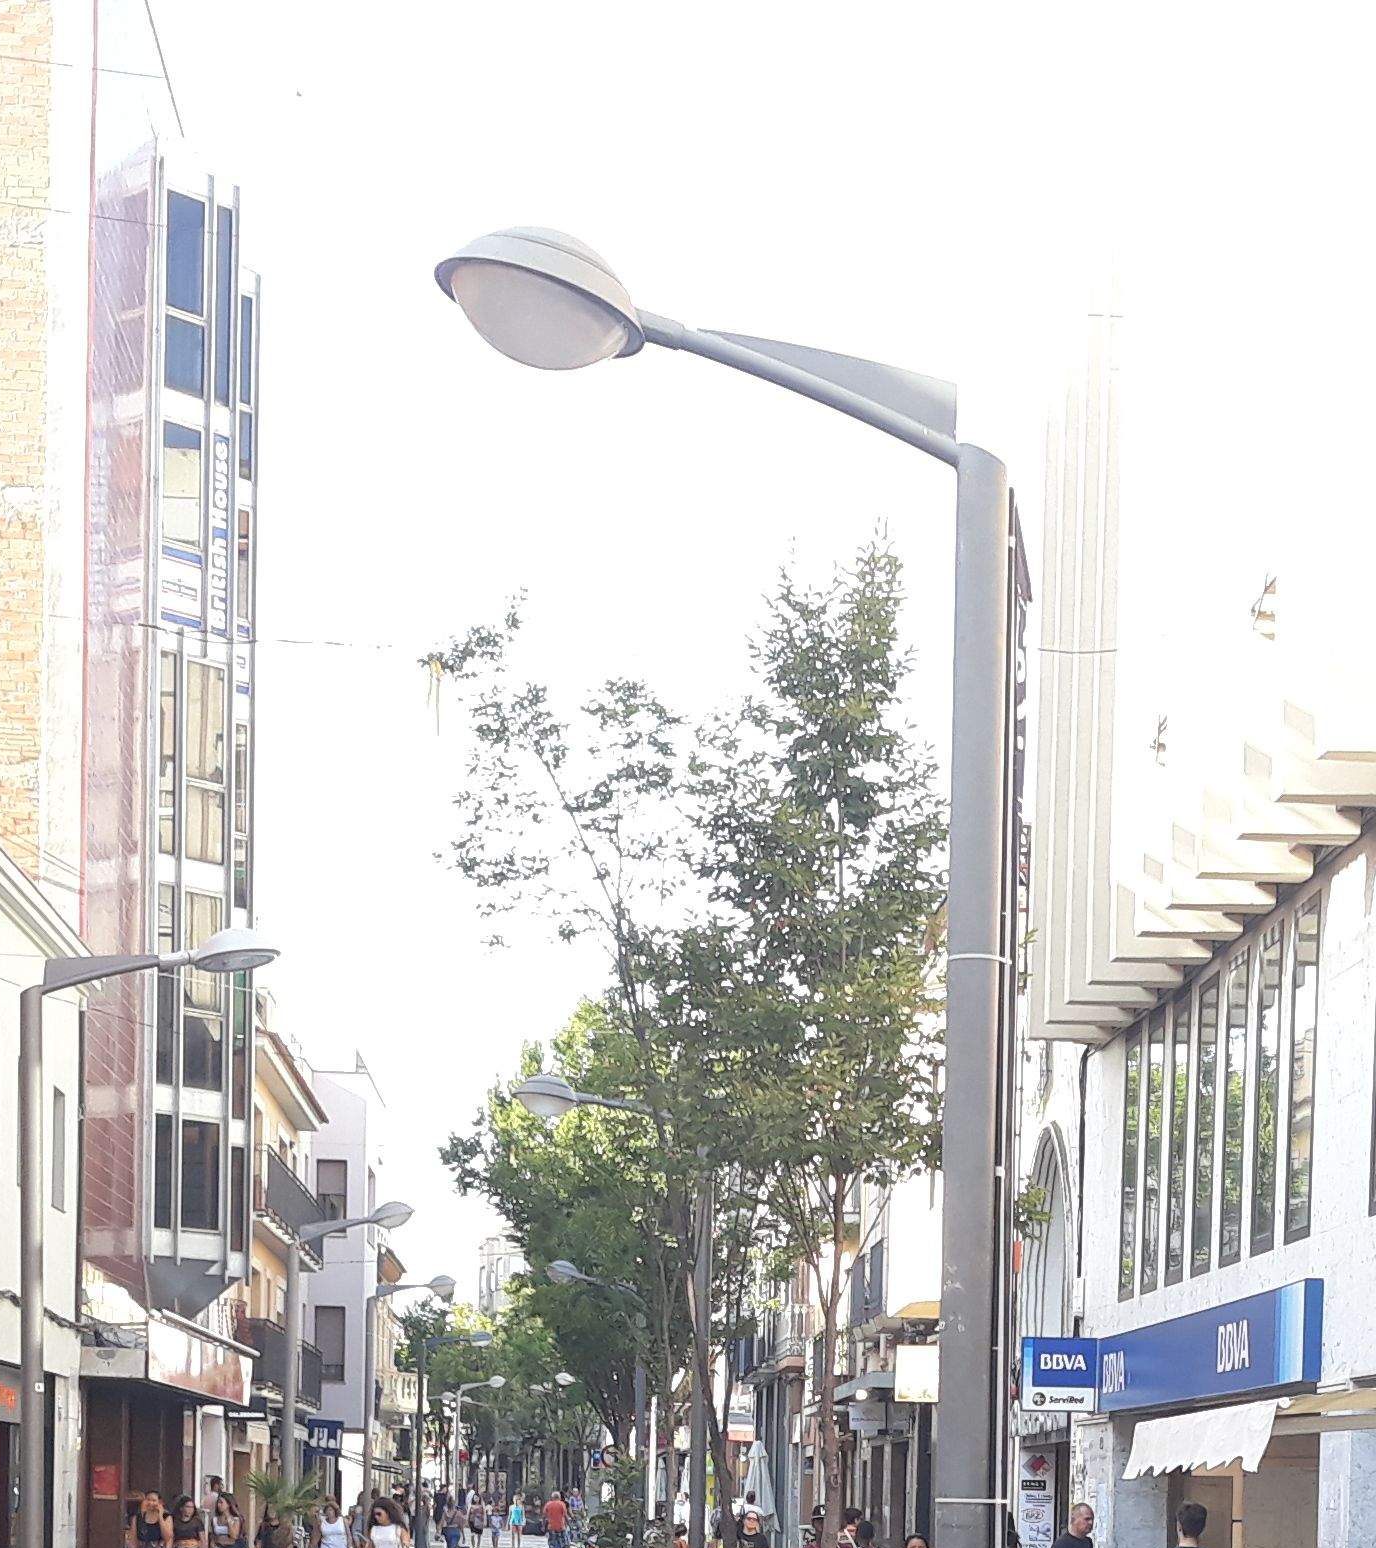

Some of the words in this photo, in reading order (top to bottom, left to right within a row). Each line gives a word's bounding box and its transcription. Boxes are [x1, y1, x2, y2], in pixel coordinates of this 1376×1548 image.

[212, 441, 228, 527] House
[211, 537, 228, 629] British
[1040, 1353, 1087, 1371] BBVA
[1102, 1350, 1125, 1394] BBVA
[1217, 1319, 1250, 1374] BBVA
